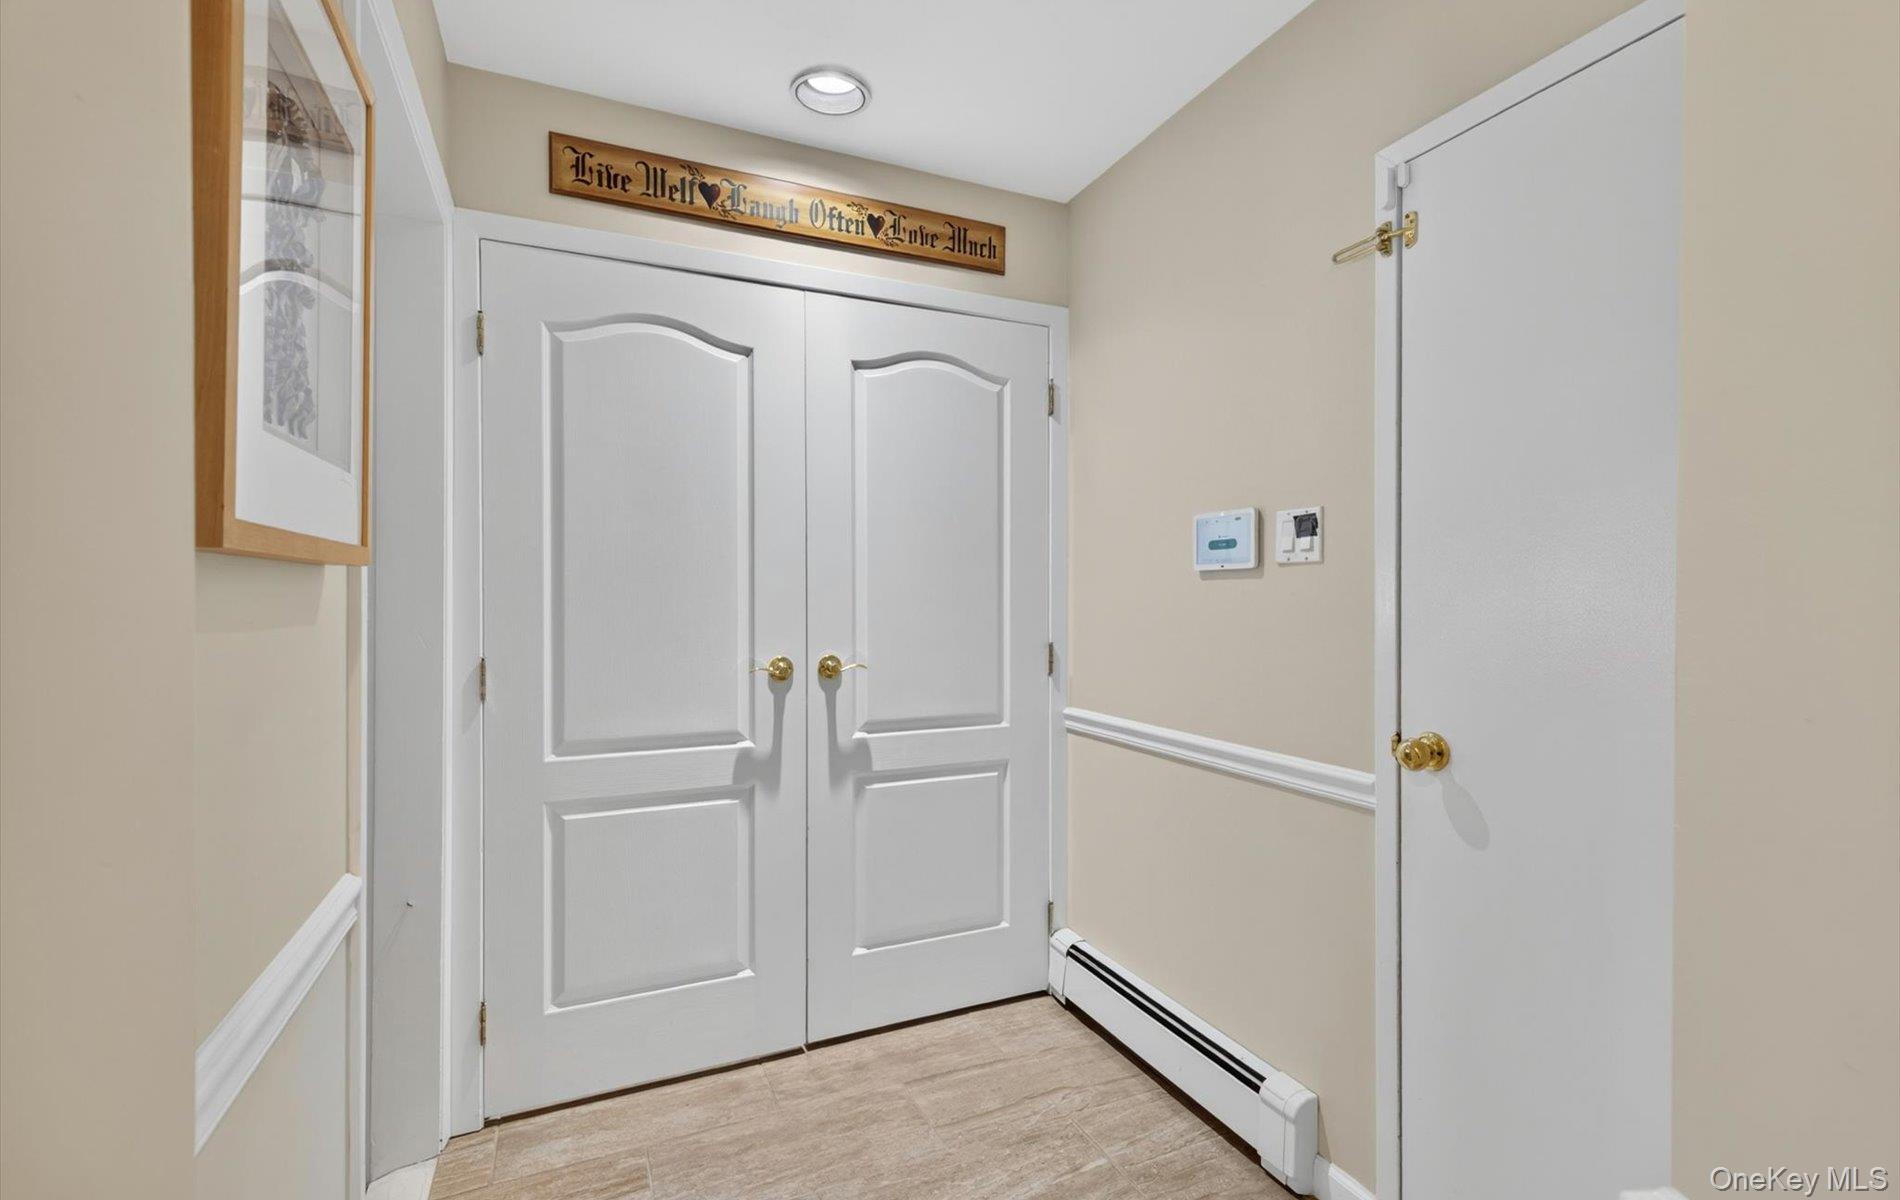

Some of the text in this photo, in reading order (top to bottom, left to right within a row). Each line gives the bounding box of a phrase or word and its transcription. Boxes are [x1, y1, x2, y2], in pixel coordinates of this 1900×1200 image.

[562, 145, 998, 260] Live Well Laugh Often Love Much
